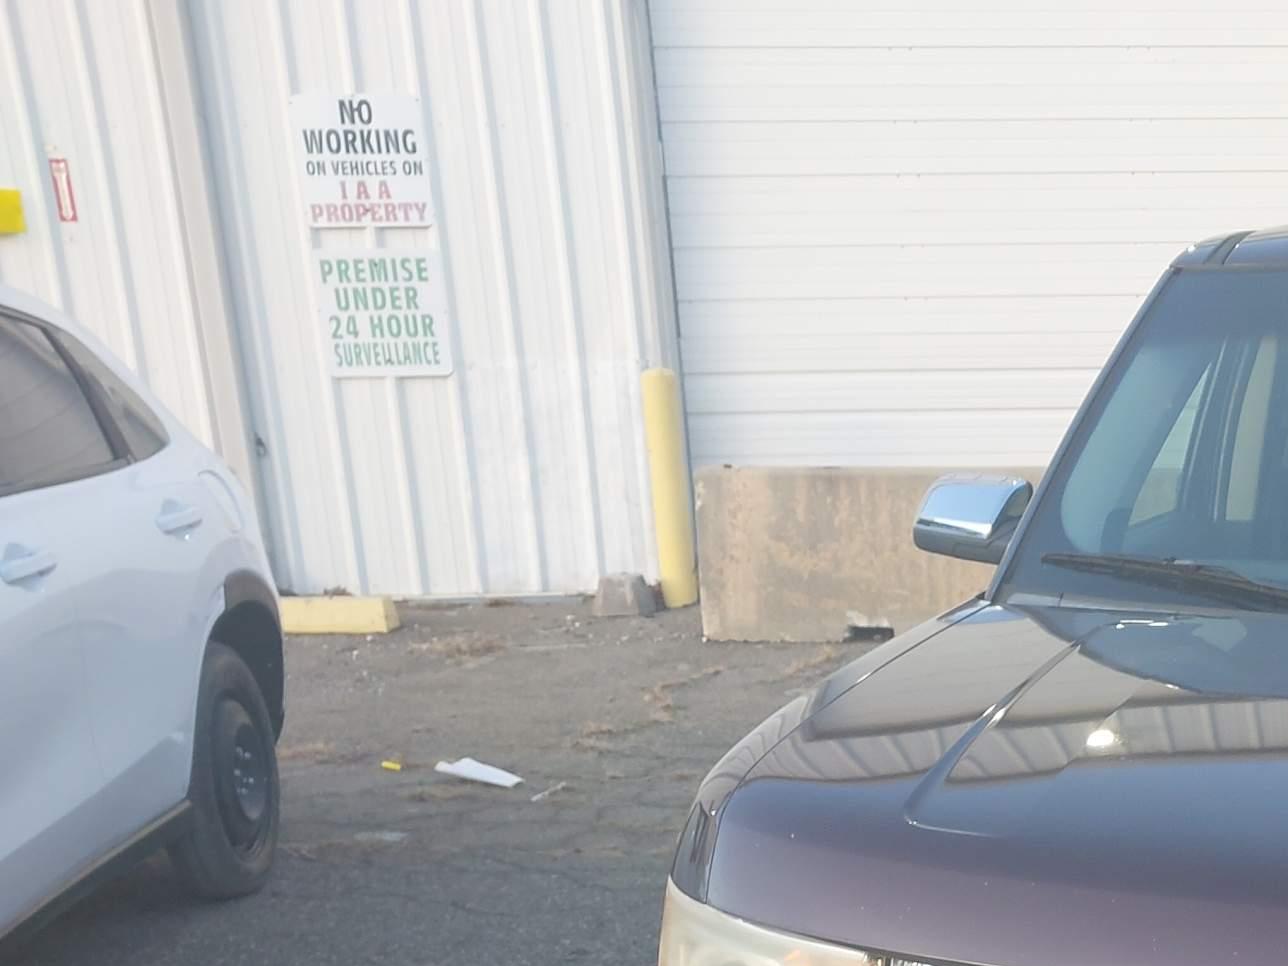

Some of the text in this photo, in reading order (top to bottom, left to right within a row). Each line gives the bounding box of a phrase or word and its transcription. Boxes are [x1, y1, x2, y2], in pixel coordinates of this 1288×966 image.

[338, 99, 373, 126] NO
[302, 129, 418, 155] WORKING
[306, 160, 424, 177] ON VEHICLES ON
[310, 202, 428, 223] PROPERTY
[319, 258, 429, 284] PREMISE
[334, 286, 420, 312] UNDER
[328, 314, 435, 340] 24 HOUR
[334, 341, 441, 368] SURVEILLANCE
